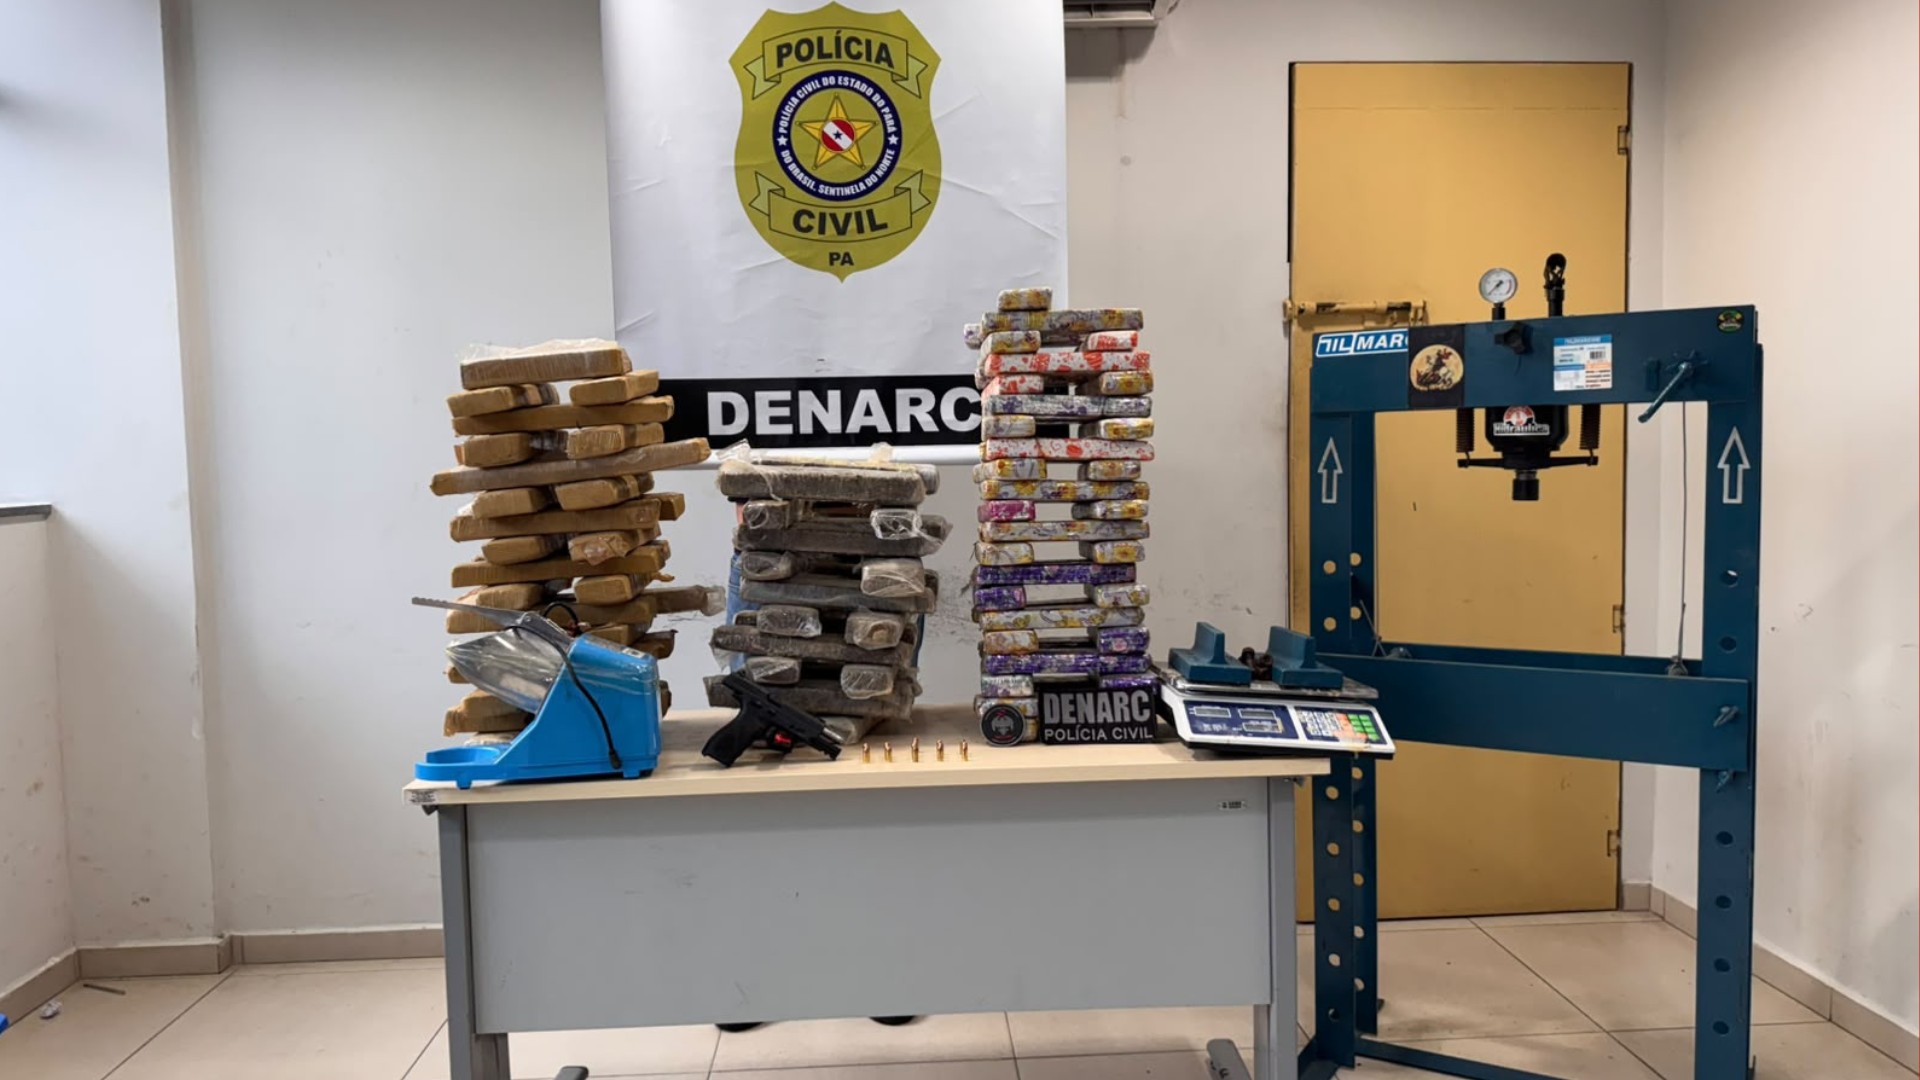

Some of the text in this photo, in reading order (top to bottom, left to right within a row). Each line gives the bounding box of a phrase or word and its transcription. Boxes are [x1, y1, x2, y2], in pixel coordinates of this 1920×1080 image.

[776, 30, 894, 68] POLÍCIA
[778, 97, 799, 134] POLÍCIA
[796, 79, 821, 99] CIVIL
[821, 75, 836, 86] DO
[837, 75, 874, 97] ESTADO
[871, 94, 886, 108] DO
[780, 149, 793, 164] DO
[817, 181, 867, 197] SENTINELA
[864, 173, 879, 187] DO
[875, 148, 895, 177] NORTE
[792, 209, 888, 236] CIVIL
[829, 252, 854, 266] PA
[707, 386, 982, 436] DENARC
[1043, 689, 1151, 725] DENARC
[1044, 724, 1153, 741] POLÍCIA CIVIL
